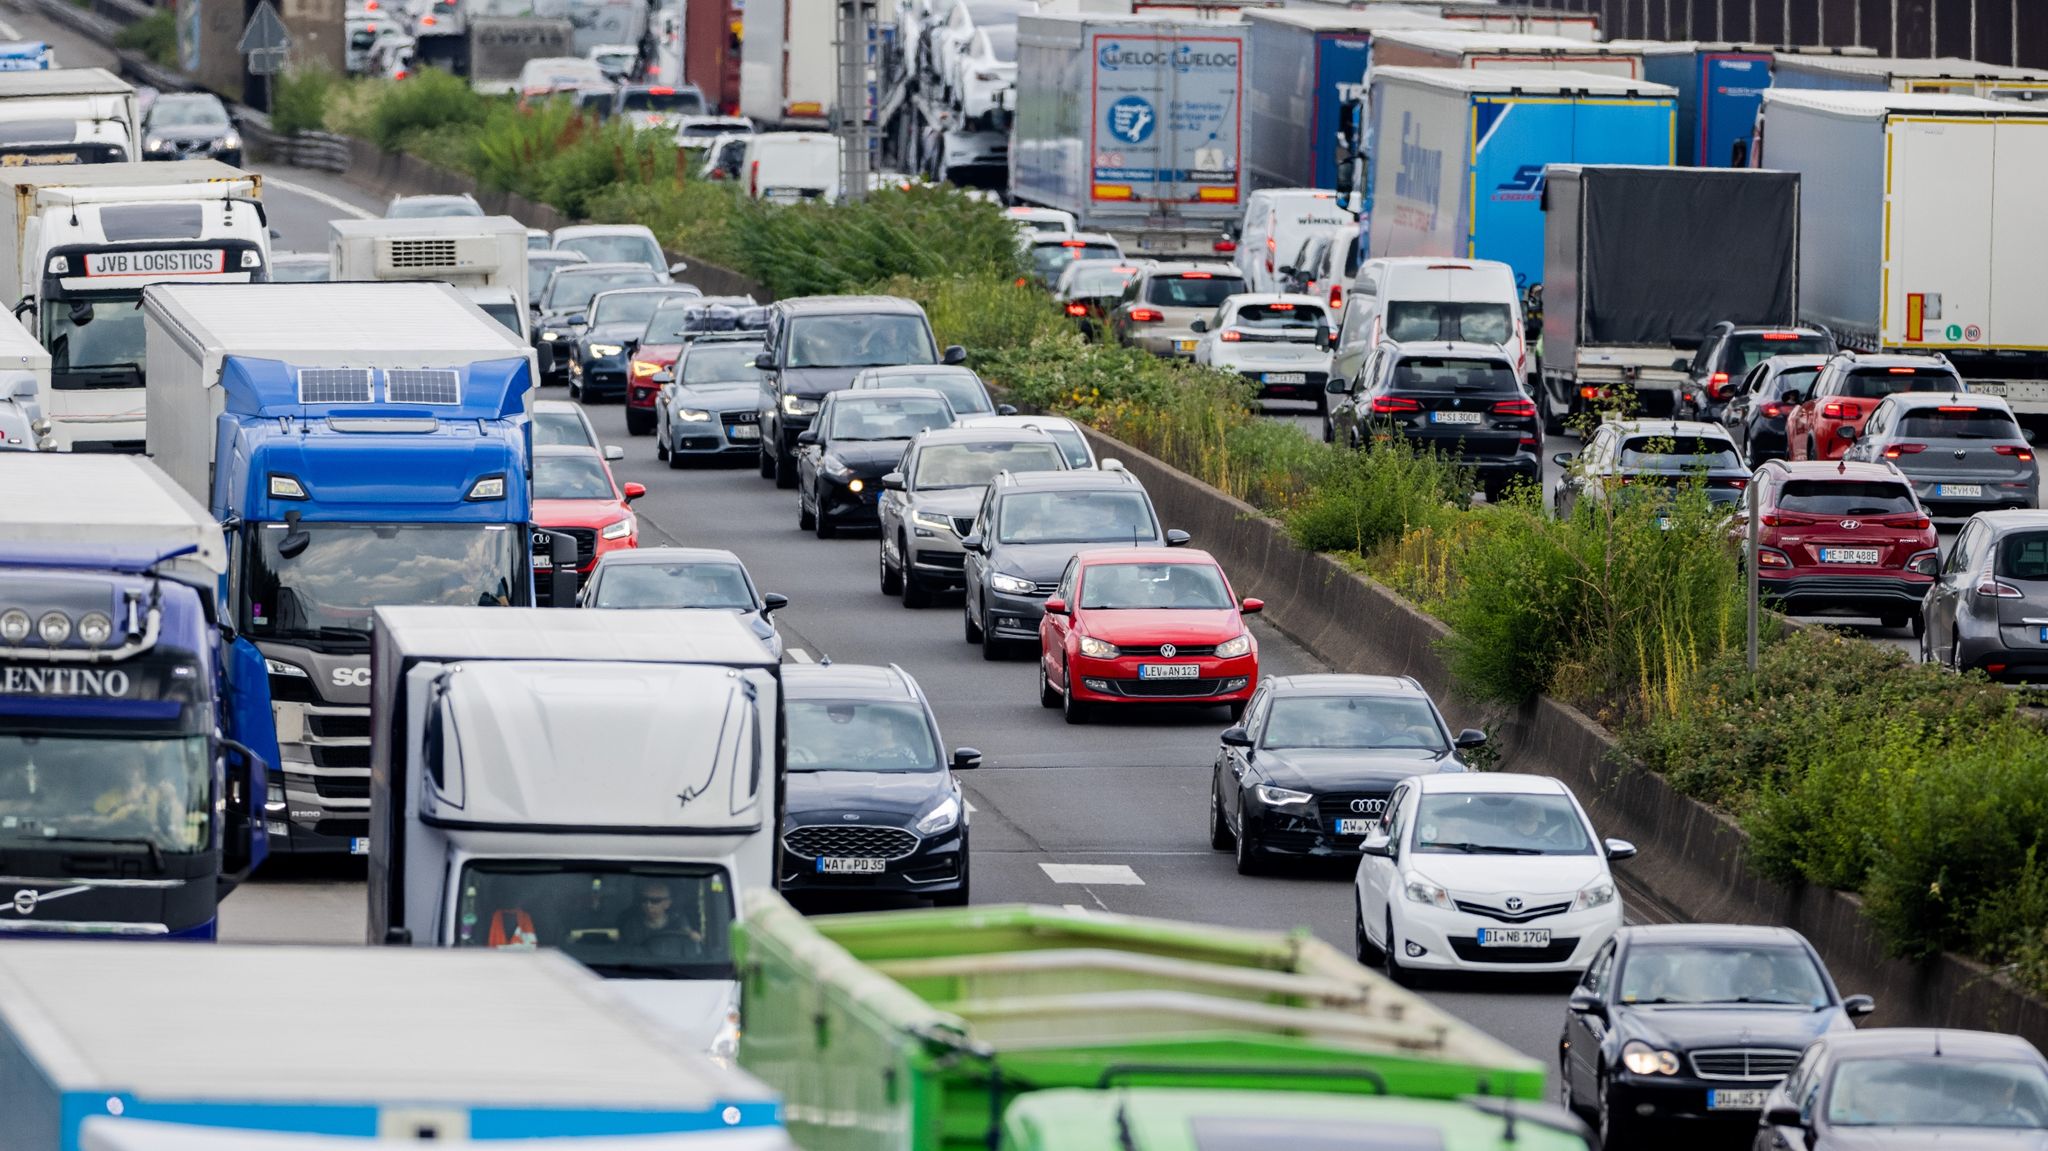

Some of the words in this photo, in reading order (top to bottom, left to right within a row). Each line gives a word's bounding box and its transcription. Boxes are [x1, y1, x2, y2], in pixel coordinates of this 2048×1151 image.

[96, 255, 128, 273] JVB
[133, 252, 214, 271] LOGISTICS
[1967, 328, 1978, 338] 80
[1941, 485, 1953, 495] BN
[1826, 550, 1837, 560] ME
[1843, 550, 1854, 560] DR
[1855, 550, 1877, 561] 488E
[1145, 666, 1162, 677] LEV
[1168, 666, 1180, 676] AN
[1181, 666, 1198, 676] 123
[0, 667, 130, 697] ENTINO
[1342, 820, 1357, 832] AW
[824, 859, 845, 870] WAT
[853, 859, 869, 870] PD
[870, 859, 885, 870] 35
[1485, 931, 1498, 942] DI
[1506, 931, 1519, 942] NB
[1523, 931, 1549, 943] 1704
